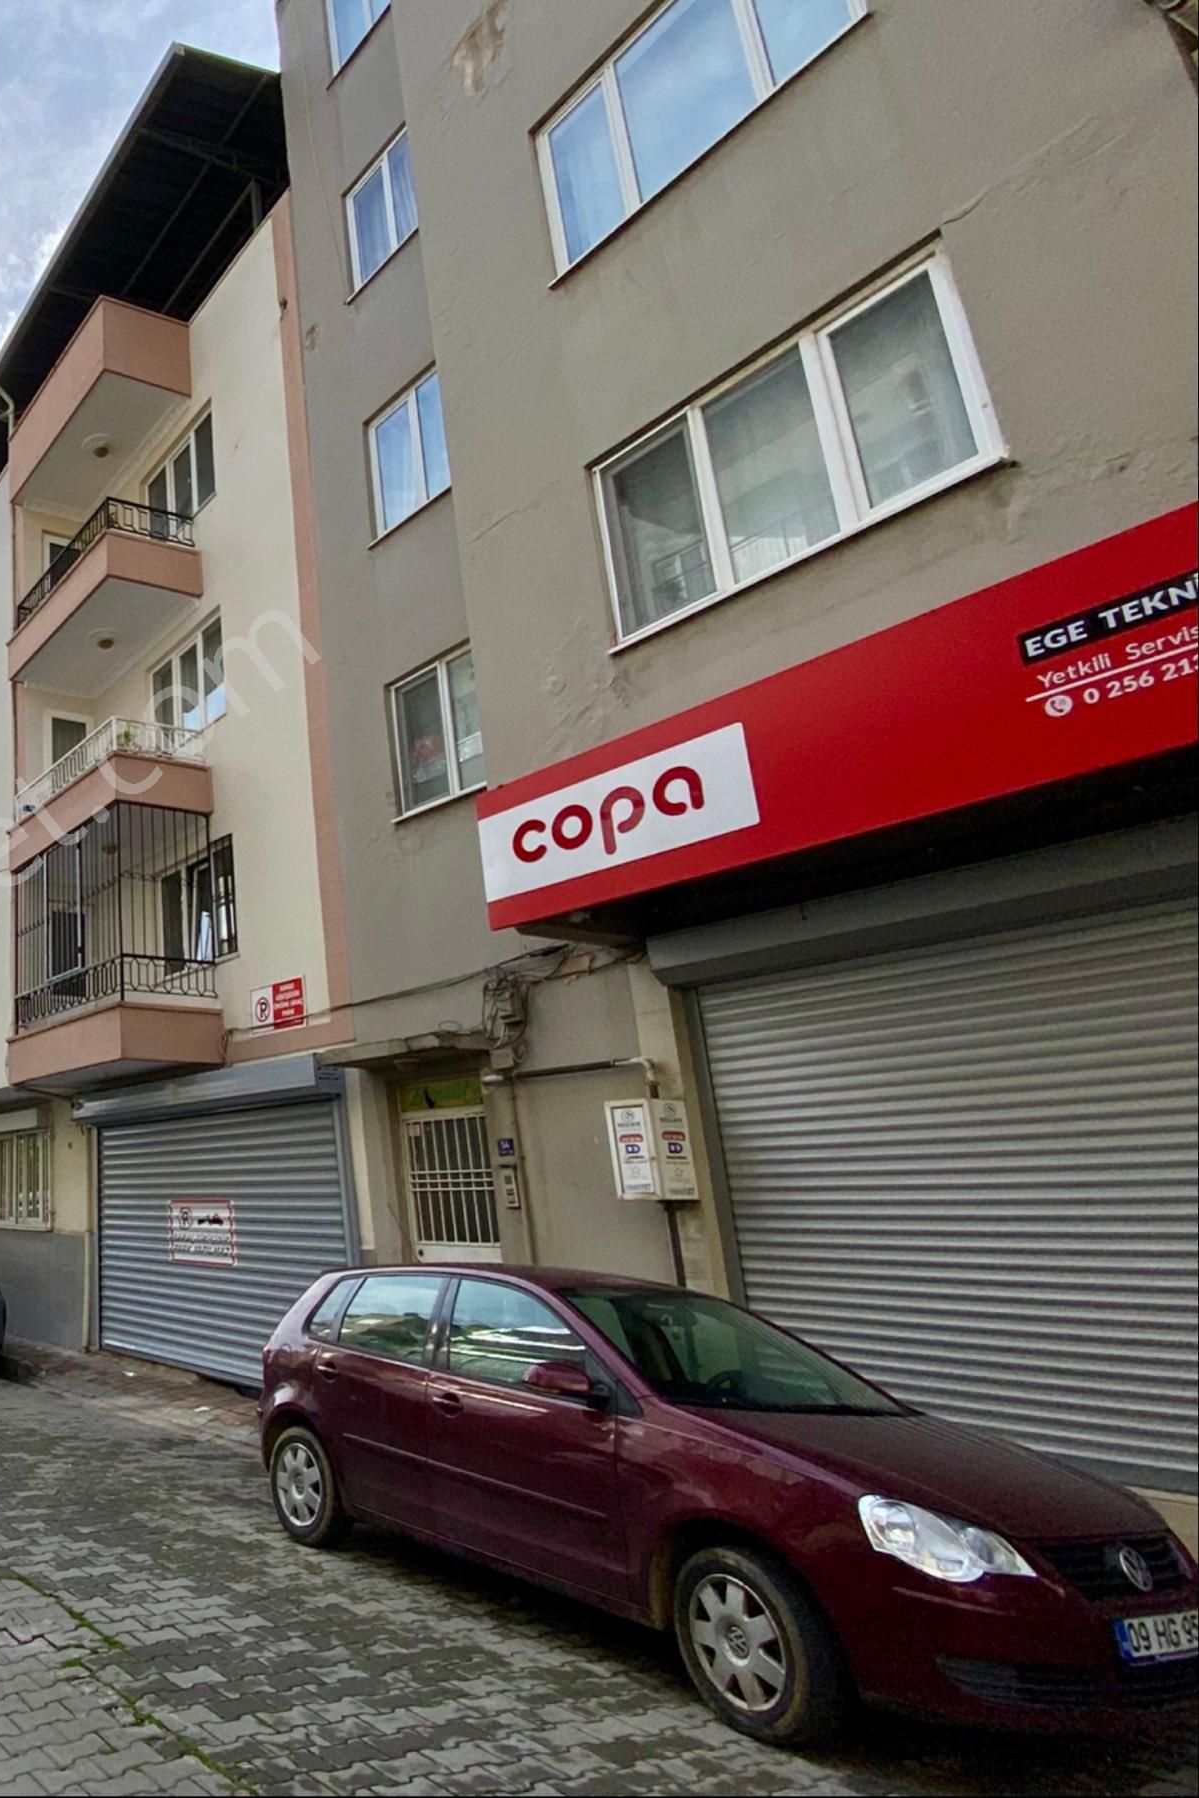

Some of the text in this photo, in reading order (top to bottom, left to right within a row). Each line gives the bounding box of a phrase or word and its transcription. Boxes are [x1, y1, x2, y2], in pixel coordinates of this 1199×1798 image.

[1024, 620, 1088, 657] EGE
[1036, 652, 1112, 689] Yetkili
[1083, 688, 1101, 704] 0
[1106, 670, 1155, 699] 256
[512, 765, 705, 864] copa
[1127, 1621, 1152, 1653] 09
[1154, 1617, 1182, 1649] HG
